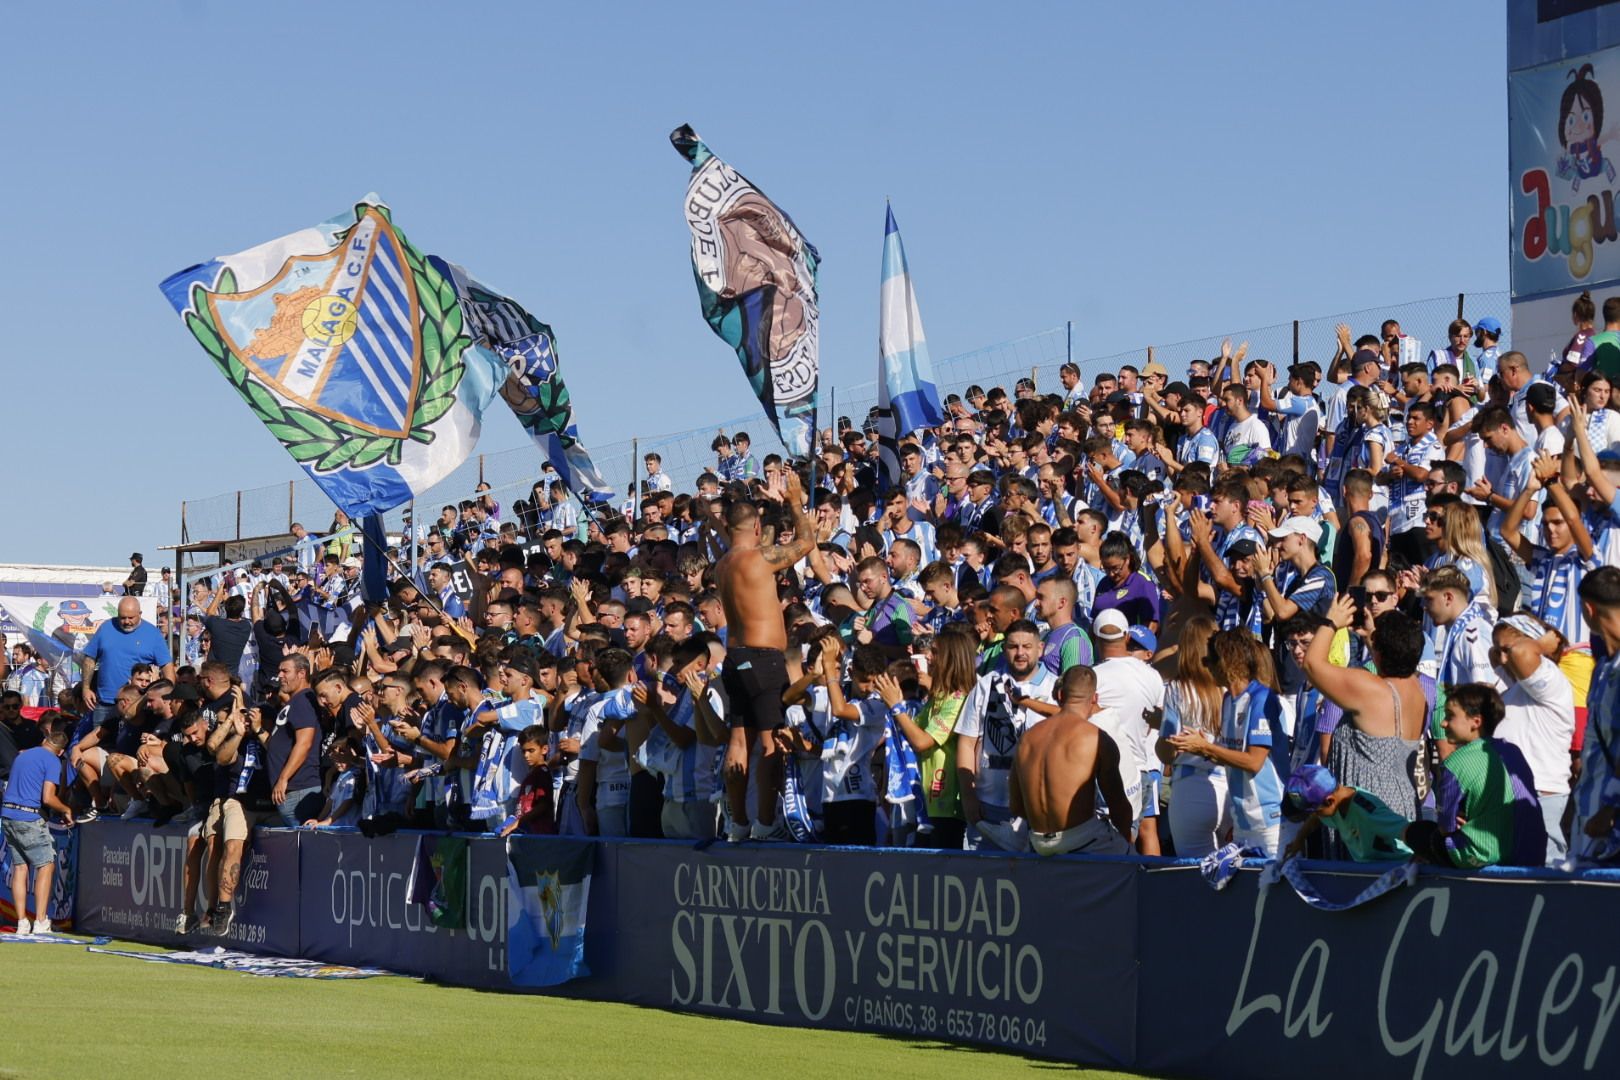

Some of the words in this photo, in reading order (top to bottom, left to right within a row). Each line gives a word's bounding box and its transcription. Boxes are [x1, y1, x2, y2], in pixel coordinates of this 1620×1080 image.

[331, 844, 438, 948] óptica
[673, 854, 832, 915] CARNICERÍA
[864, 871, 1021, 937] CALIDAD
[671, 909, 837, 1021] SIXTO
[844, 930, 866, 985] Y
[876, 932, 1044, 1005] SERVICIO
[1225, 887, 1333, 1039] La
[844, 994, 861, 1027] C/
[864, 994, 917, 1035] BAÑOS,
[920, 1004, 937, 1033] 38
[947, 1008, 974, 1038] 653
[977, 1013, 996, 1041] 78
[999, 1015, 1021, 1045] 06
[1024, 1017, 1047, 1048] 04
